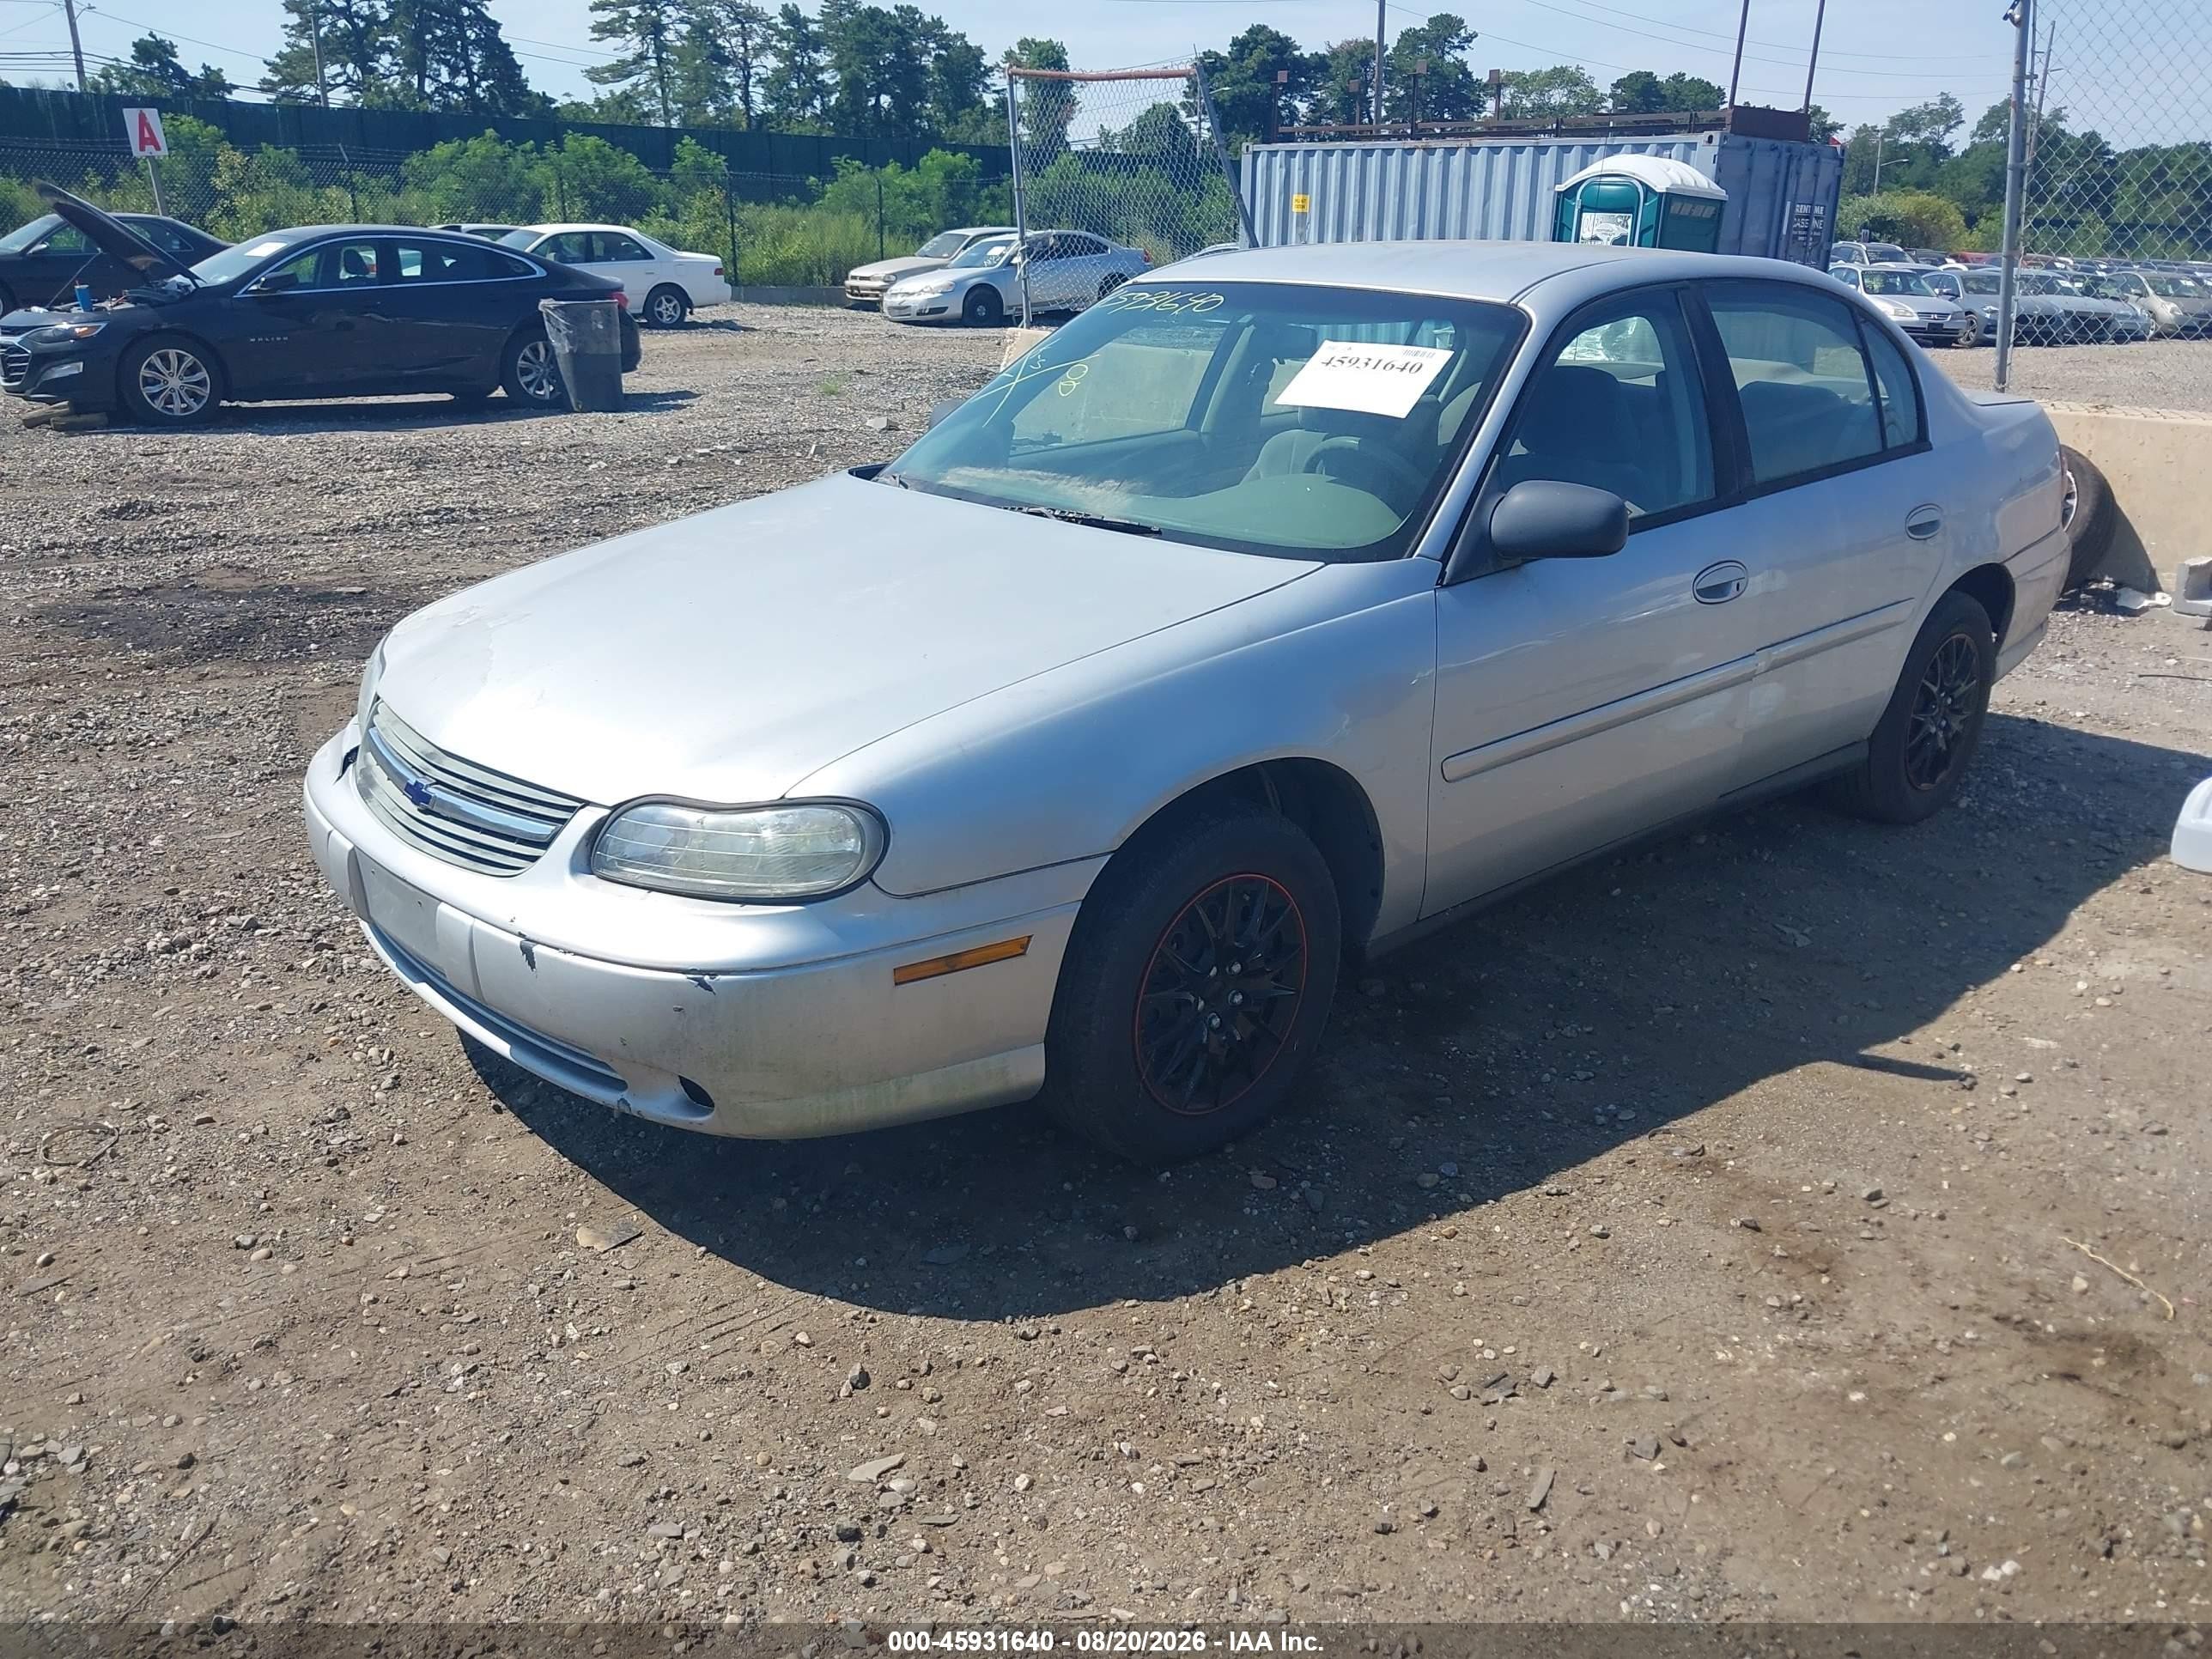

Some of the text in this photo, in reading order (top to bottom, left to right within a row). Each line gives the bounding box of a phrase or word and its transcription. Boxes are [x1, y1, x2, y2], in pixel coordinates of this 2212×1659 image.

[138, 110, 161, 152] A
[1814, 205, 1825, 215] ME
[1321, 356, 1424, 374] 45931640
